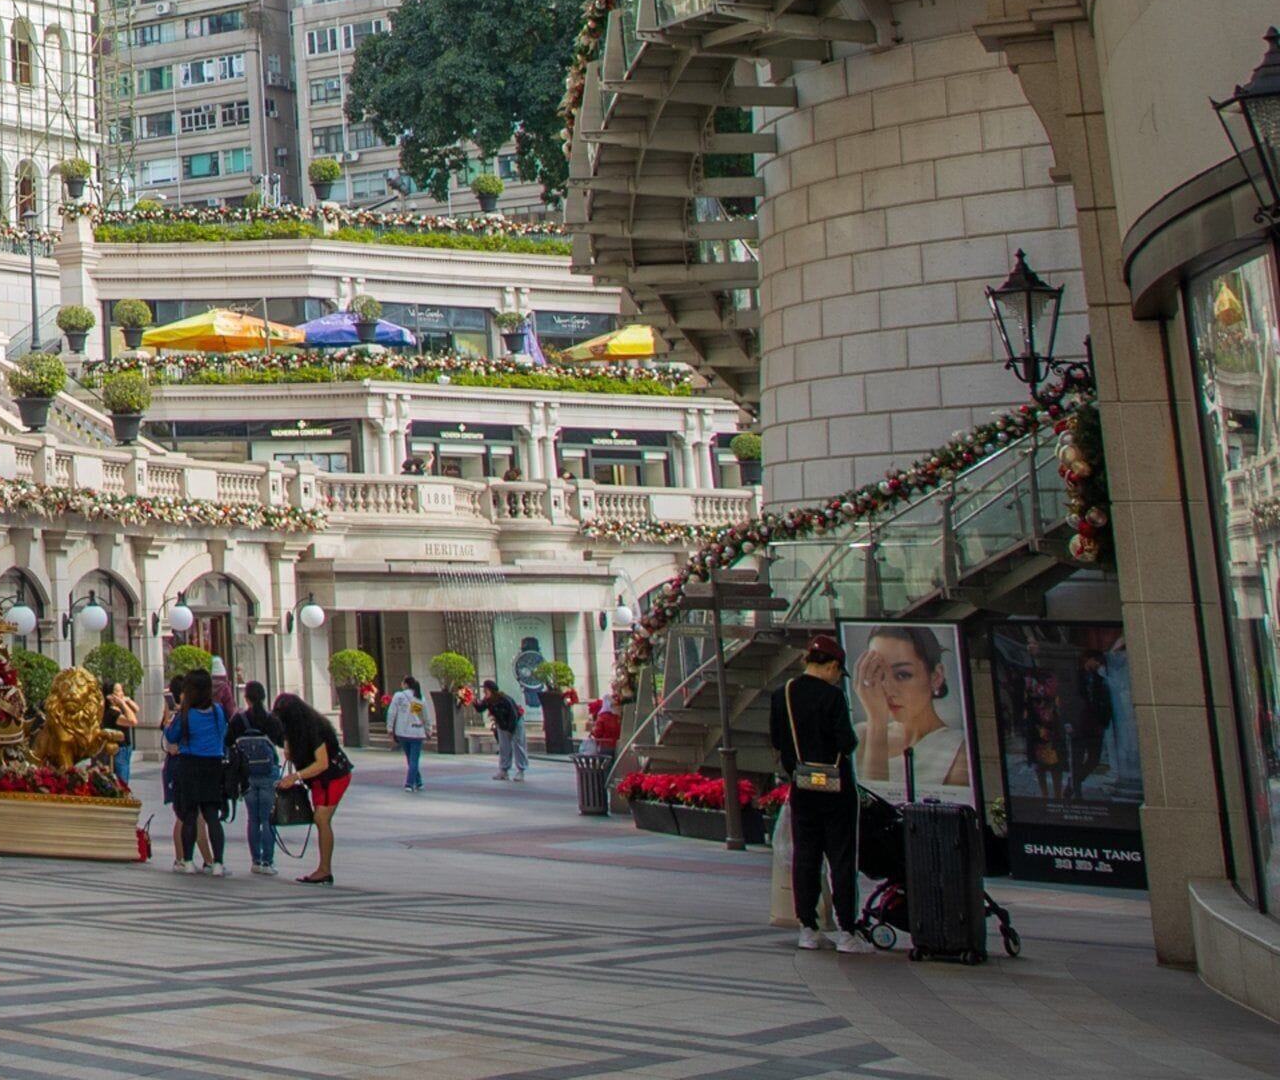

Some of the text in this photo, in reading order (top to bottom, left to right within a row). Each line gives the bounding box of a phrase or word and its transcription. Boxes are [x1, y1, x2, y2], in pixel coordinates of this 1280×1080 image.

[427, 493, 452, 505] 1881
[425, 543, 475, 556] HERITAGE
[1024, 844, 1142, 862] SHANGHAI TANG
